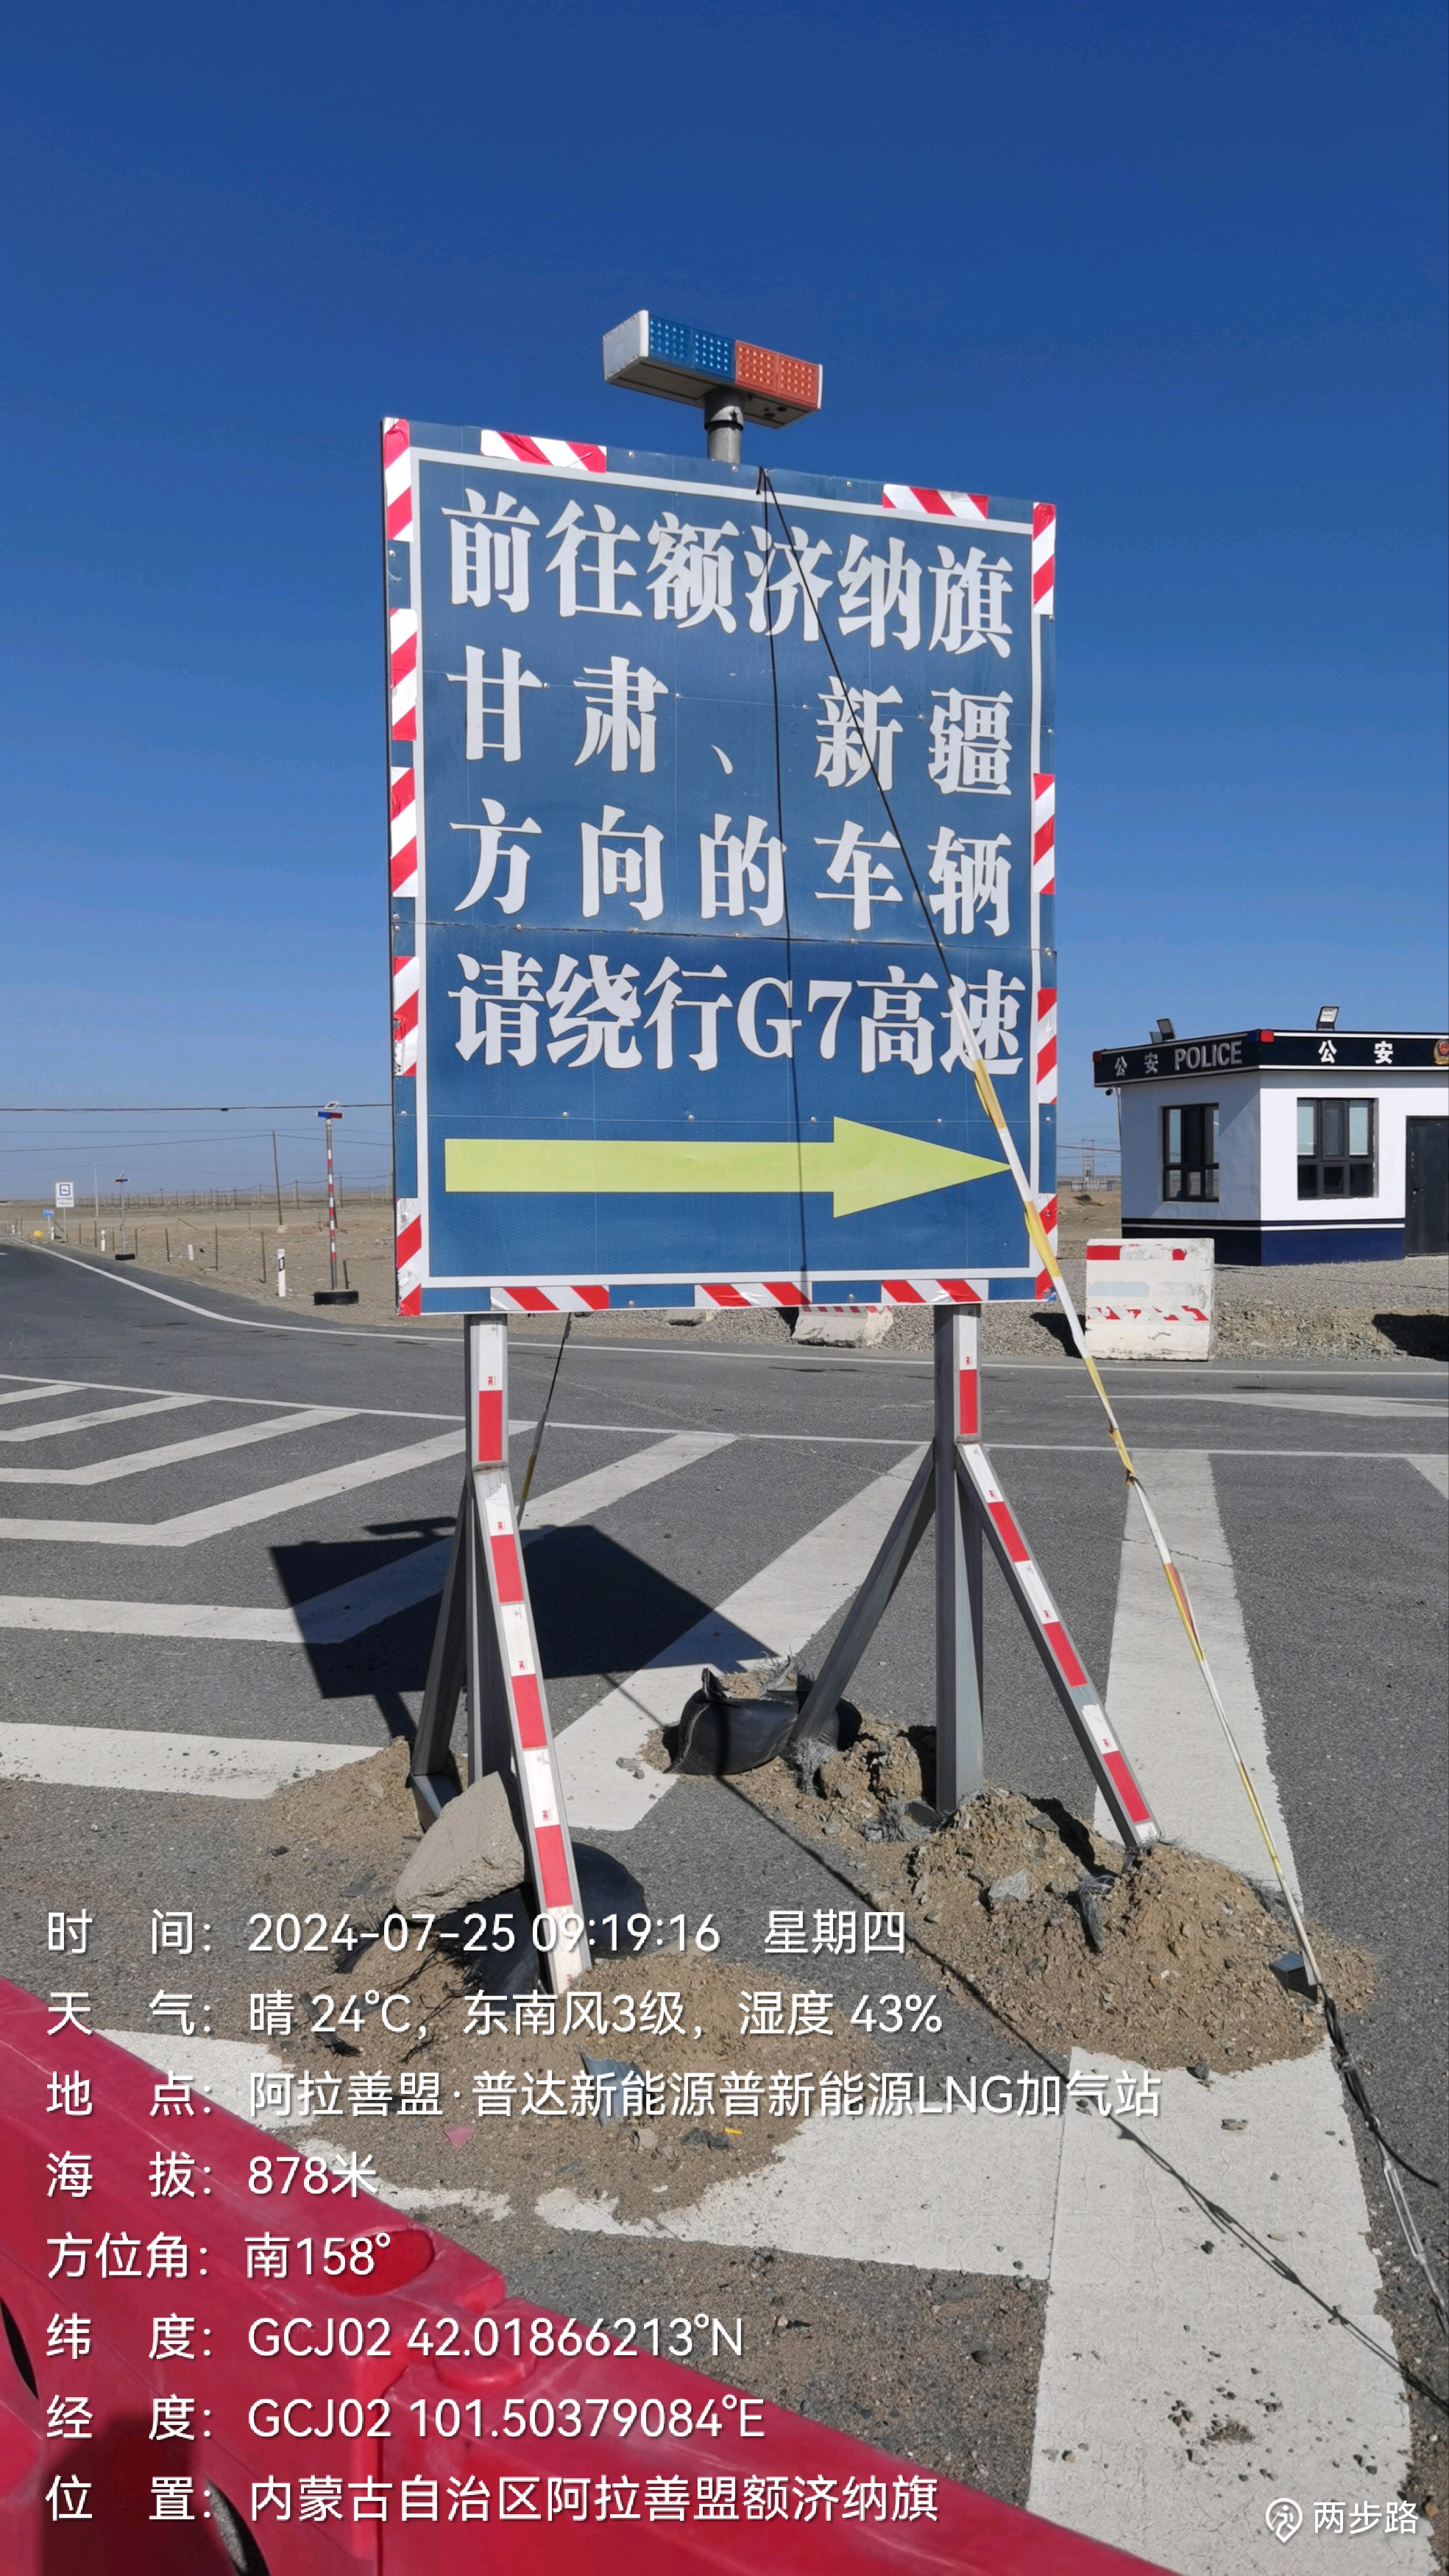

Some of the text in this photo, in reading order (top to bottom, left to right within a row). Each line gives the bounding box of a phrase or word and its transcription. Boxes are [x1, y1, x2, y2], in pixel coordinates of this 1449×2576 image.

[442, 488, 1013, 659] 前往额济纳旗
[449, 799, 1013, 938] 方向的车辆
[447, 950, 1027, 1076] 请绕行G7高速
[1114, 1040, 1242, 1077] 公安 POLICE
[1318, 1040, 1394, 1065] 公安
